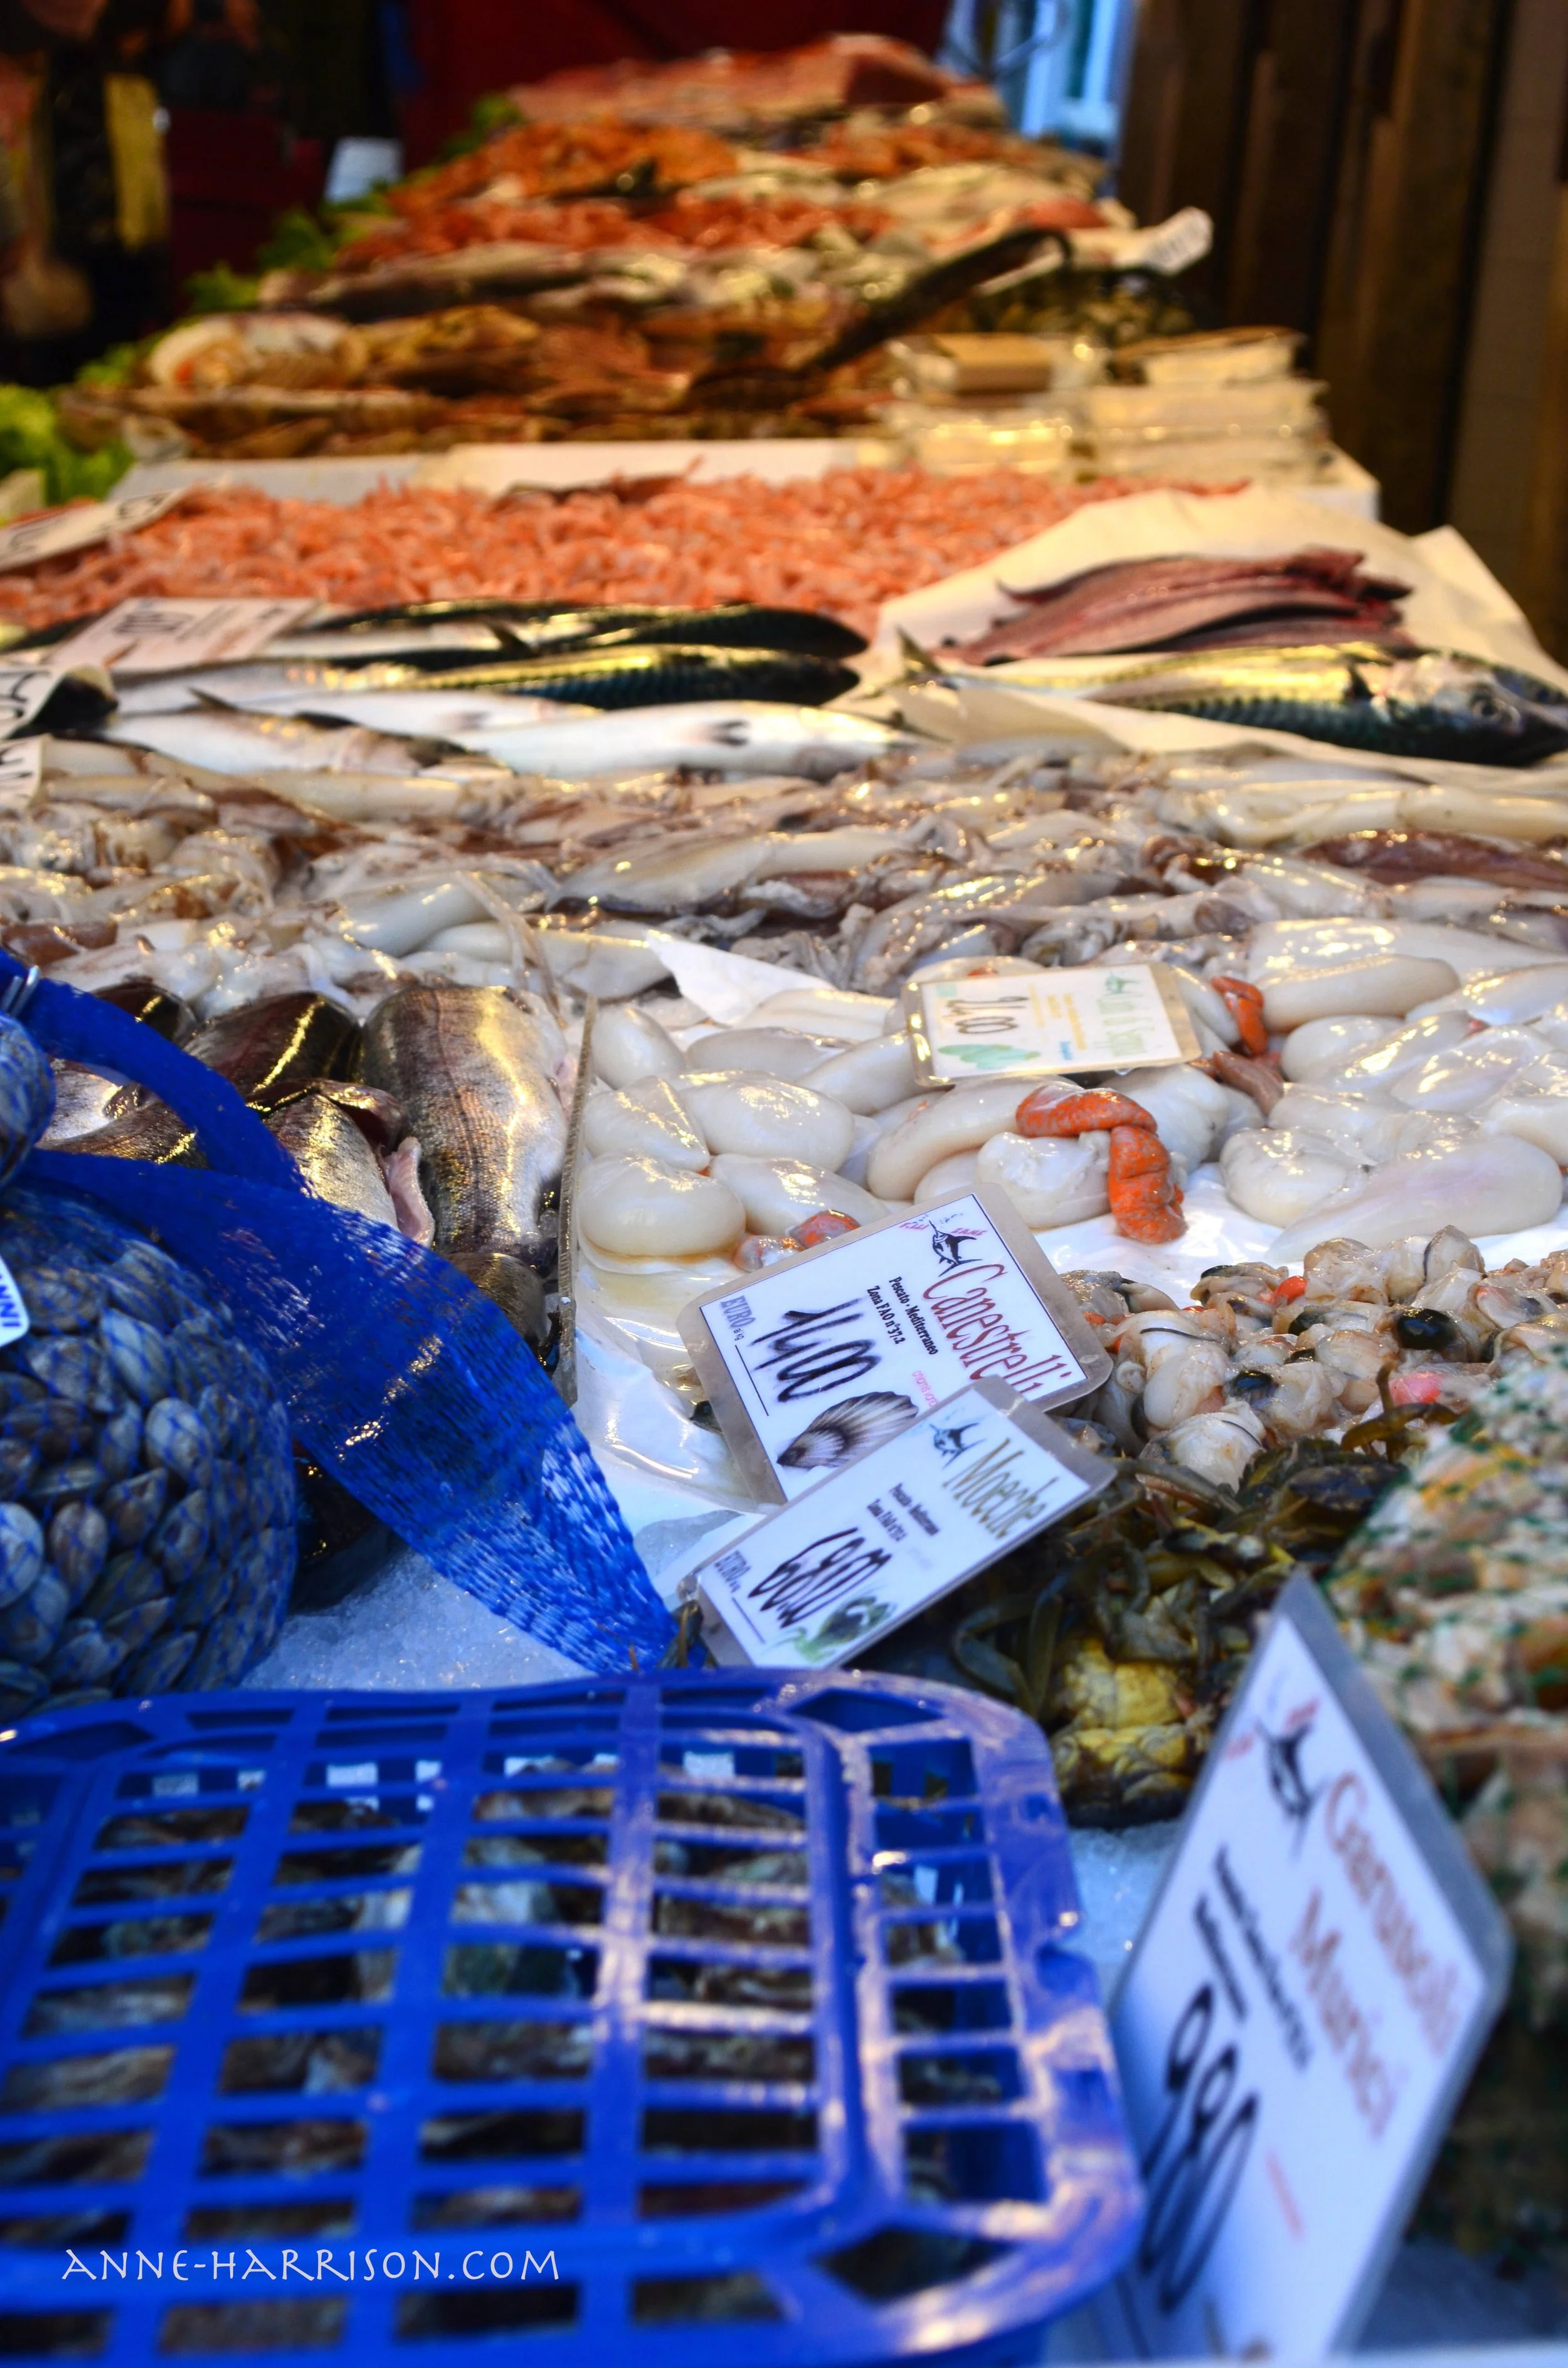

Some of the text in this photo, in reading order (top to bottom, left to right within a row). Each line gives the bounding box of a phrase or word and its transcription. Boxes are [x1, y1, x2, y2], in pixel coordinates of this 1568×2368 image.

[720, 1295, 756, 1328] EURO
[867, 1285, 883, 1305] Zona
[876, 1302, 896, 1321] FAO
[889, 1277, 910, 1304] Pescato
[904, 1305, 939, 1355] Mediterraneo
[923, 1263, 1072, 1393] Canestrelli
[941, 1437, 1059, 1539] Moeche
